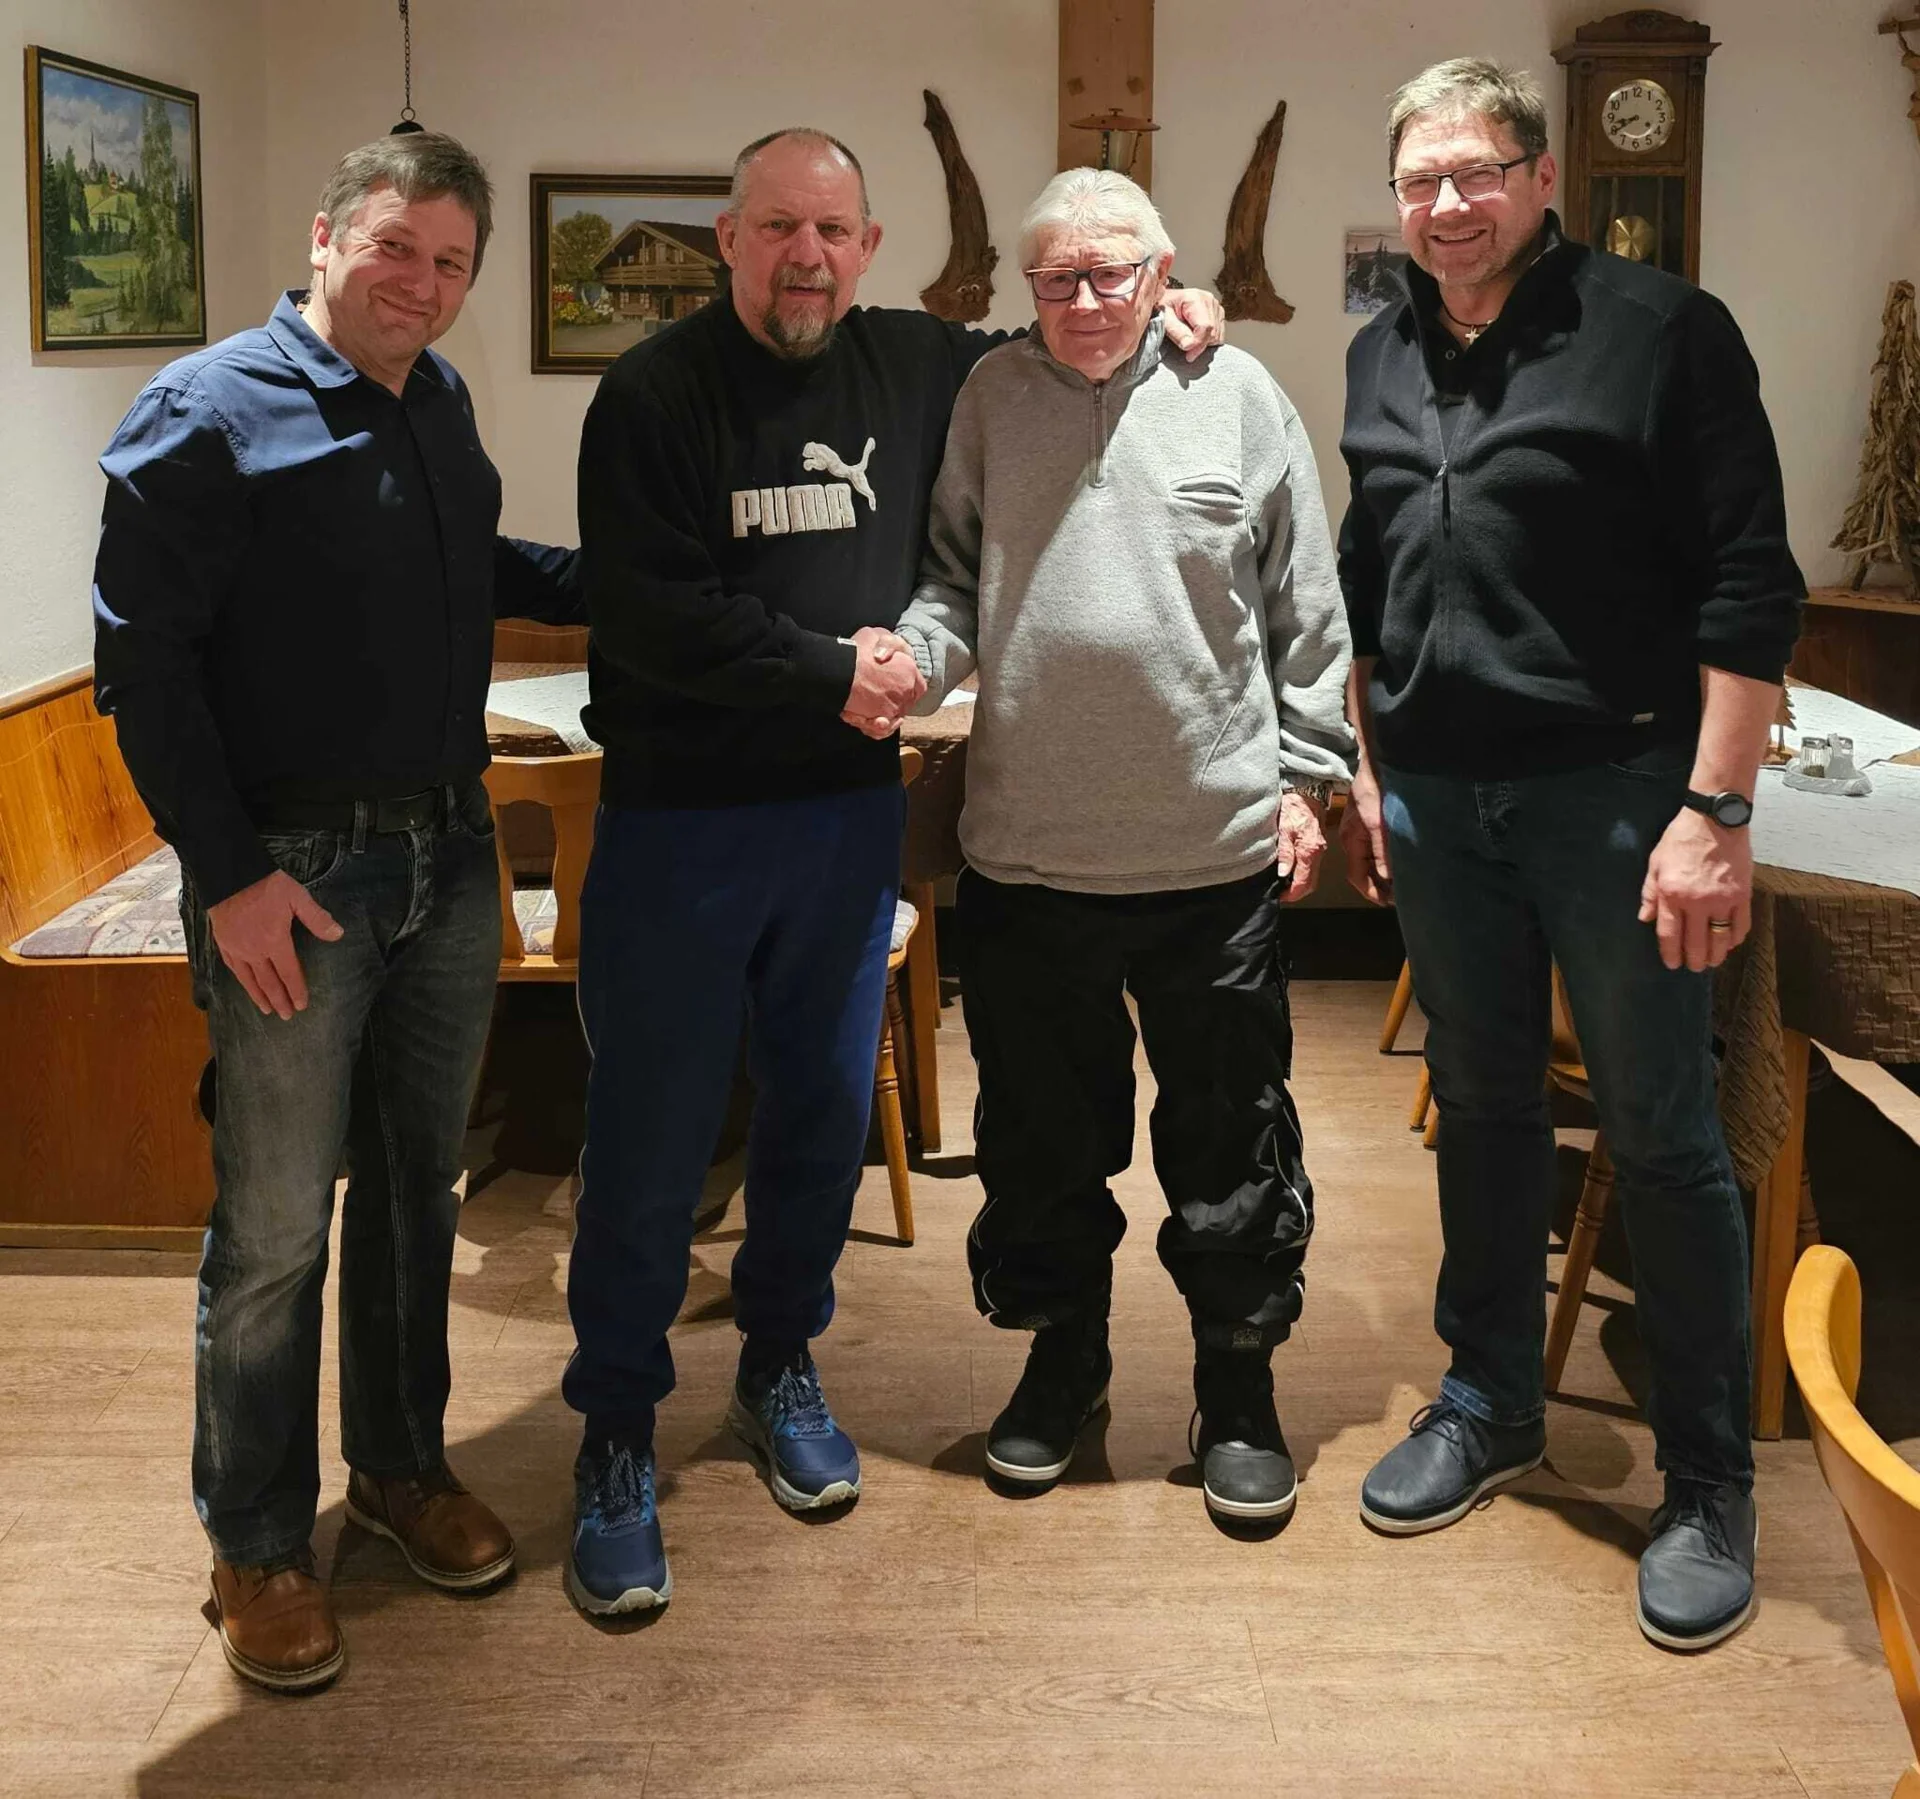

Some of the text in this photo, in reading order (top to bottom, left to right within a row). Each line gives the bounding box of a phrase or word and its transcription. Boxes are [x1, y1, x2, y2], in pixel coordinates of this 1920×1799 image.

[1621, 91, 1628, 101] 11
[1632, 87, 1642, 98] 12
[1611, 100, 1620, 111] 10
[1655, 99, 1663, 110] 2
[1607, 113, 1615, 122] 9
[1659, 113, 1666, 123] 3
[1611, 126, 1617, 135] 8
[1653, 126, 1661, 135] 4
[1620, 135, 1626, 146] 7
[1632, 139, 1640, 150] 6
[1645, 135, 1652, 145] 5
[731, 483, 856, 538] PUMA
